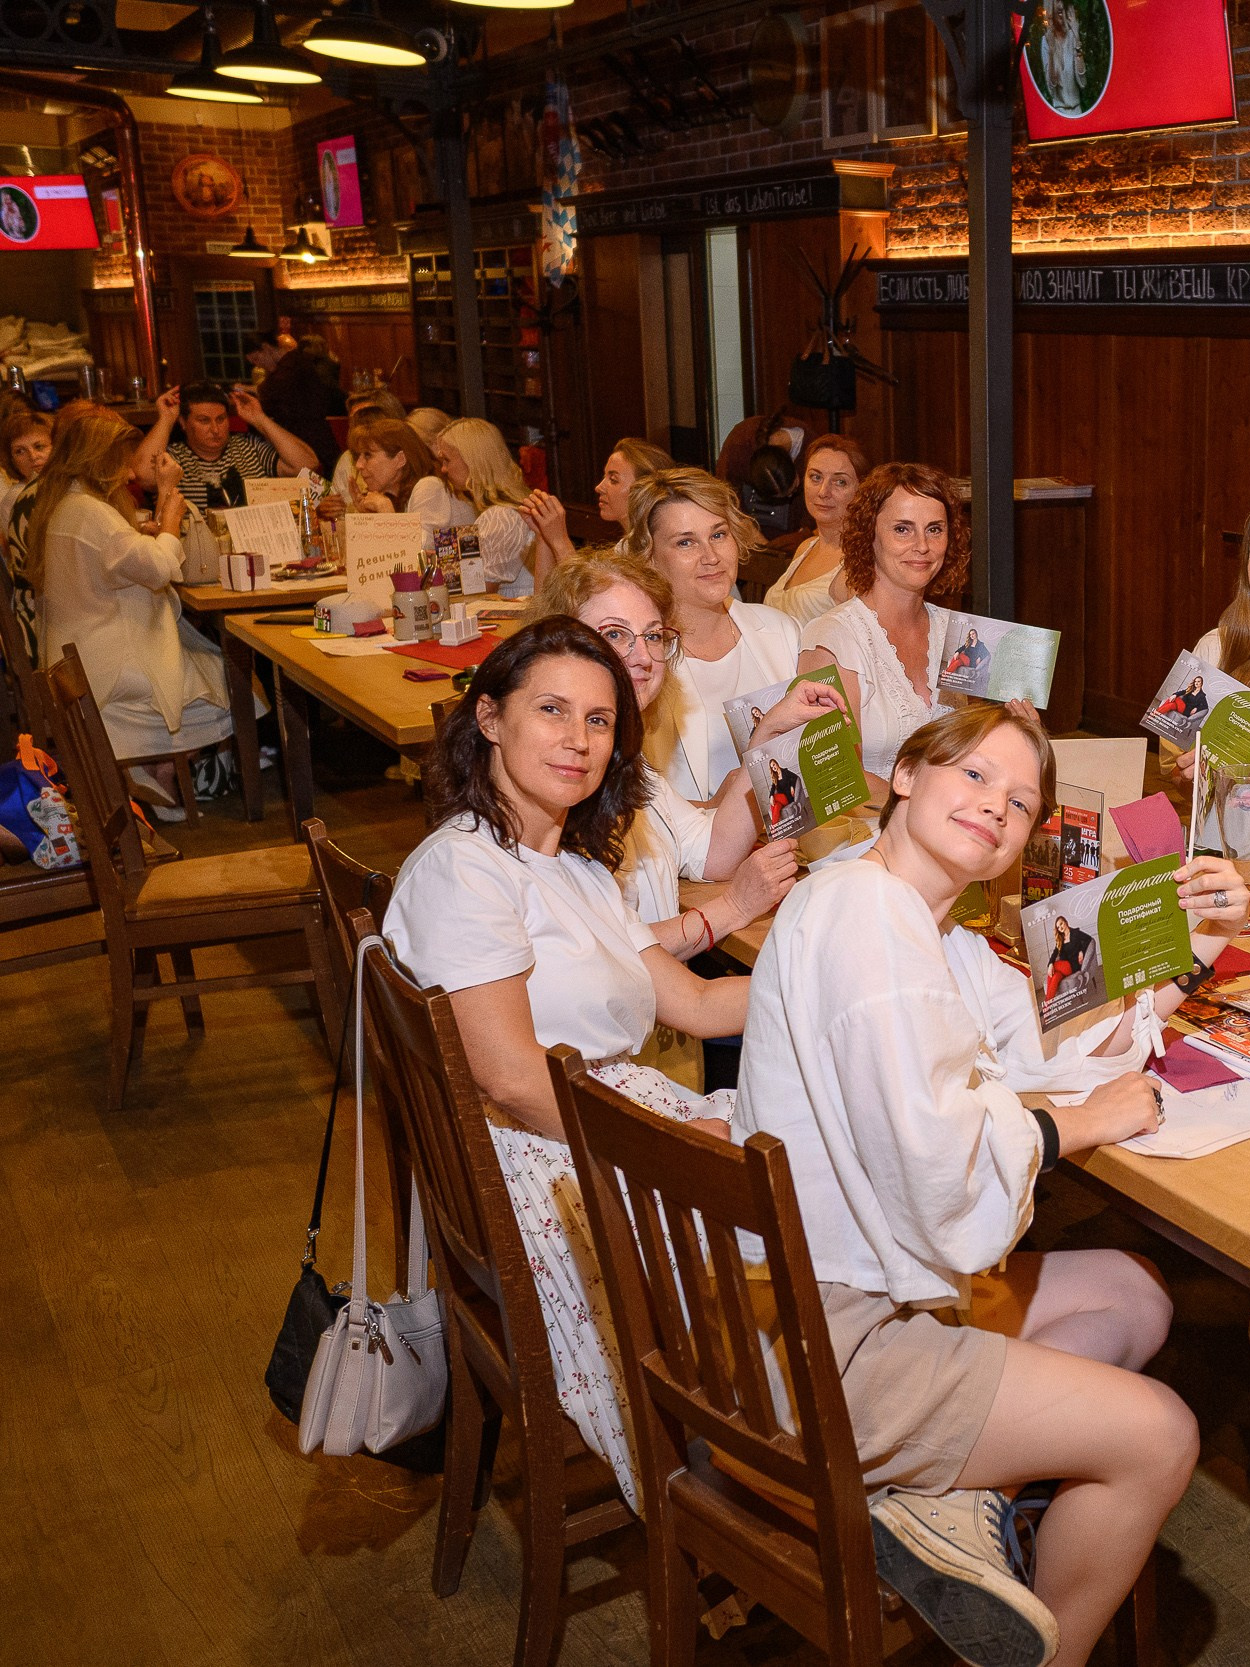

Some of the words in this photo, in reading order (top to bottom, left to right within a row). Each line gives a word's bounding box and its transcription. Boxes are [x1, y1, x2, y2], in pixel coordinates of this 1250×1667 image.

[1113, 269, 1136, 299] ТЫ
[1140, 268, 1215, 300] ЖИВЕШЬ
[356, 549, 406, 570] Девичья
[358, 563, 414, 586] фамия
[1063, 866, 1074, 877] 25
[1118, 898, 1162, 919] Подарочный
[1120, 906, 1162, 925] Сертификат
